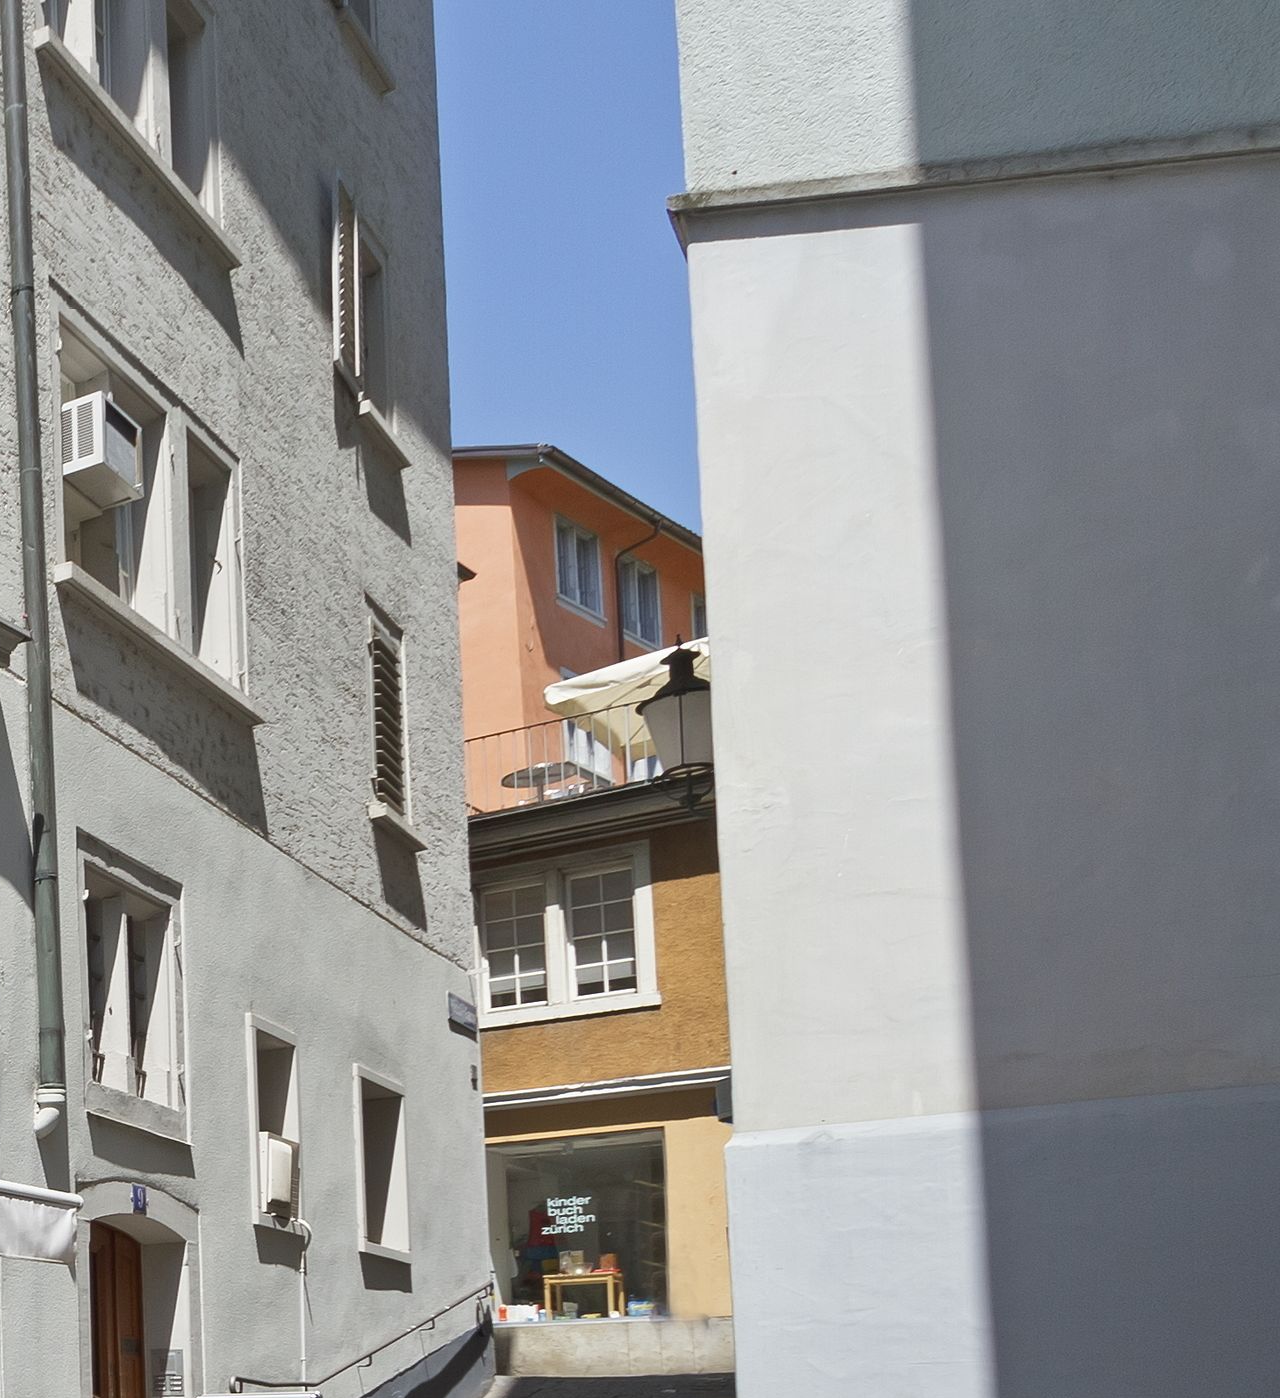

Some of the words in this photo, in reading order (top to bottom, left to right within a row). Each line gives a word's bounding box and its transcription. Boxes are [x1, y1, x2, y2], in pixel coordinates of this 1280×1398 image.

[546, 1196, 592, 1207] kinder
[547, 1206, 583, 1216] buch
[555, 1214, 596, 1224] laden
[541, 1224, 584, 1235] zürich
